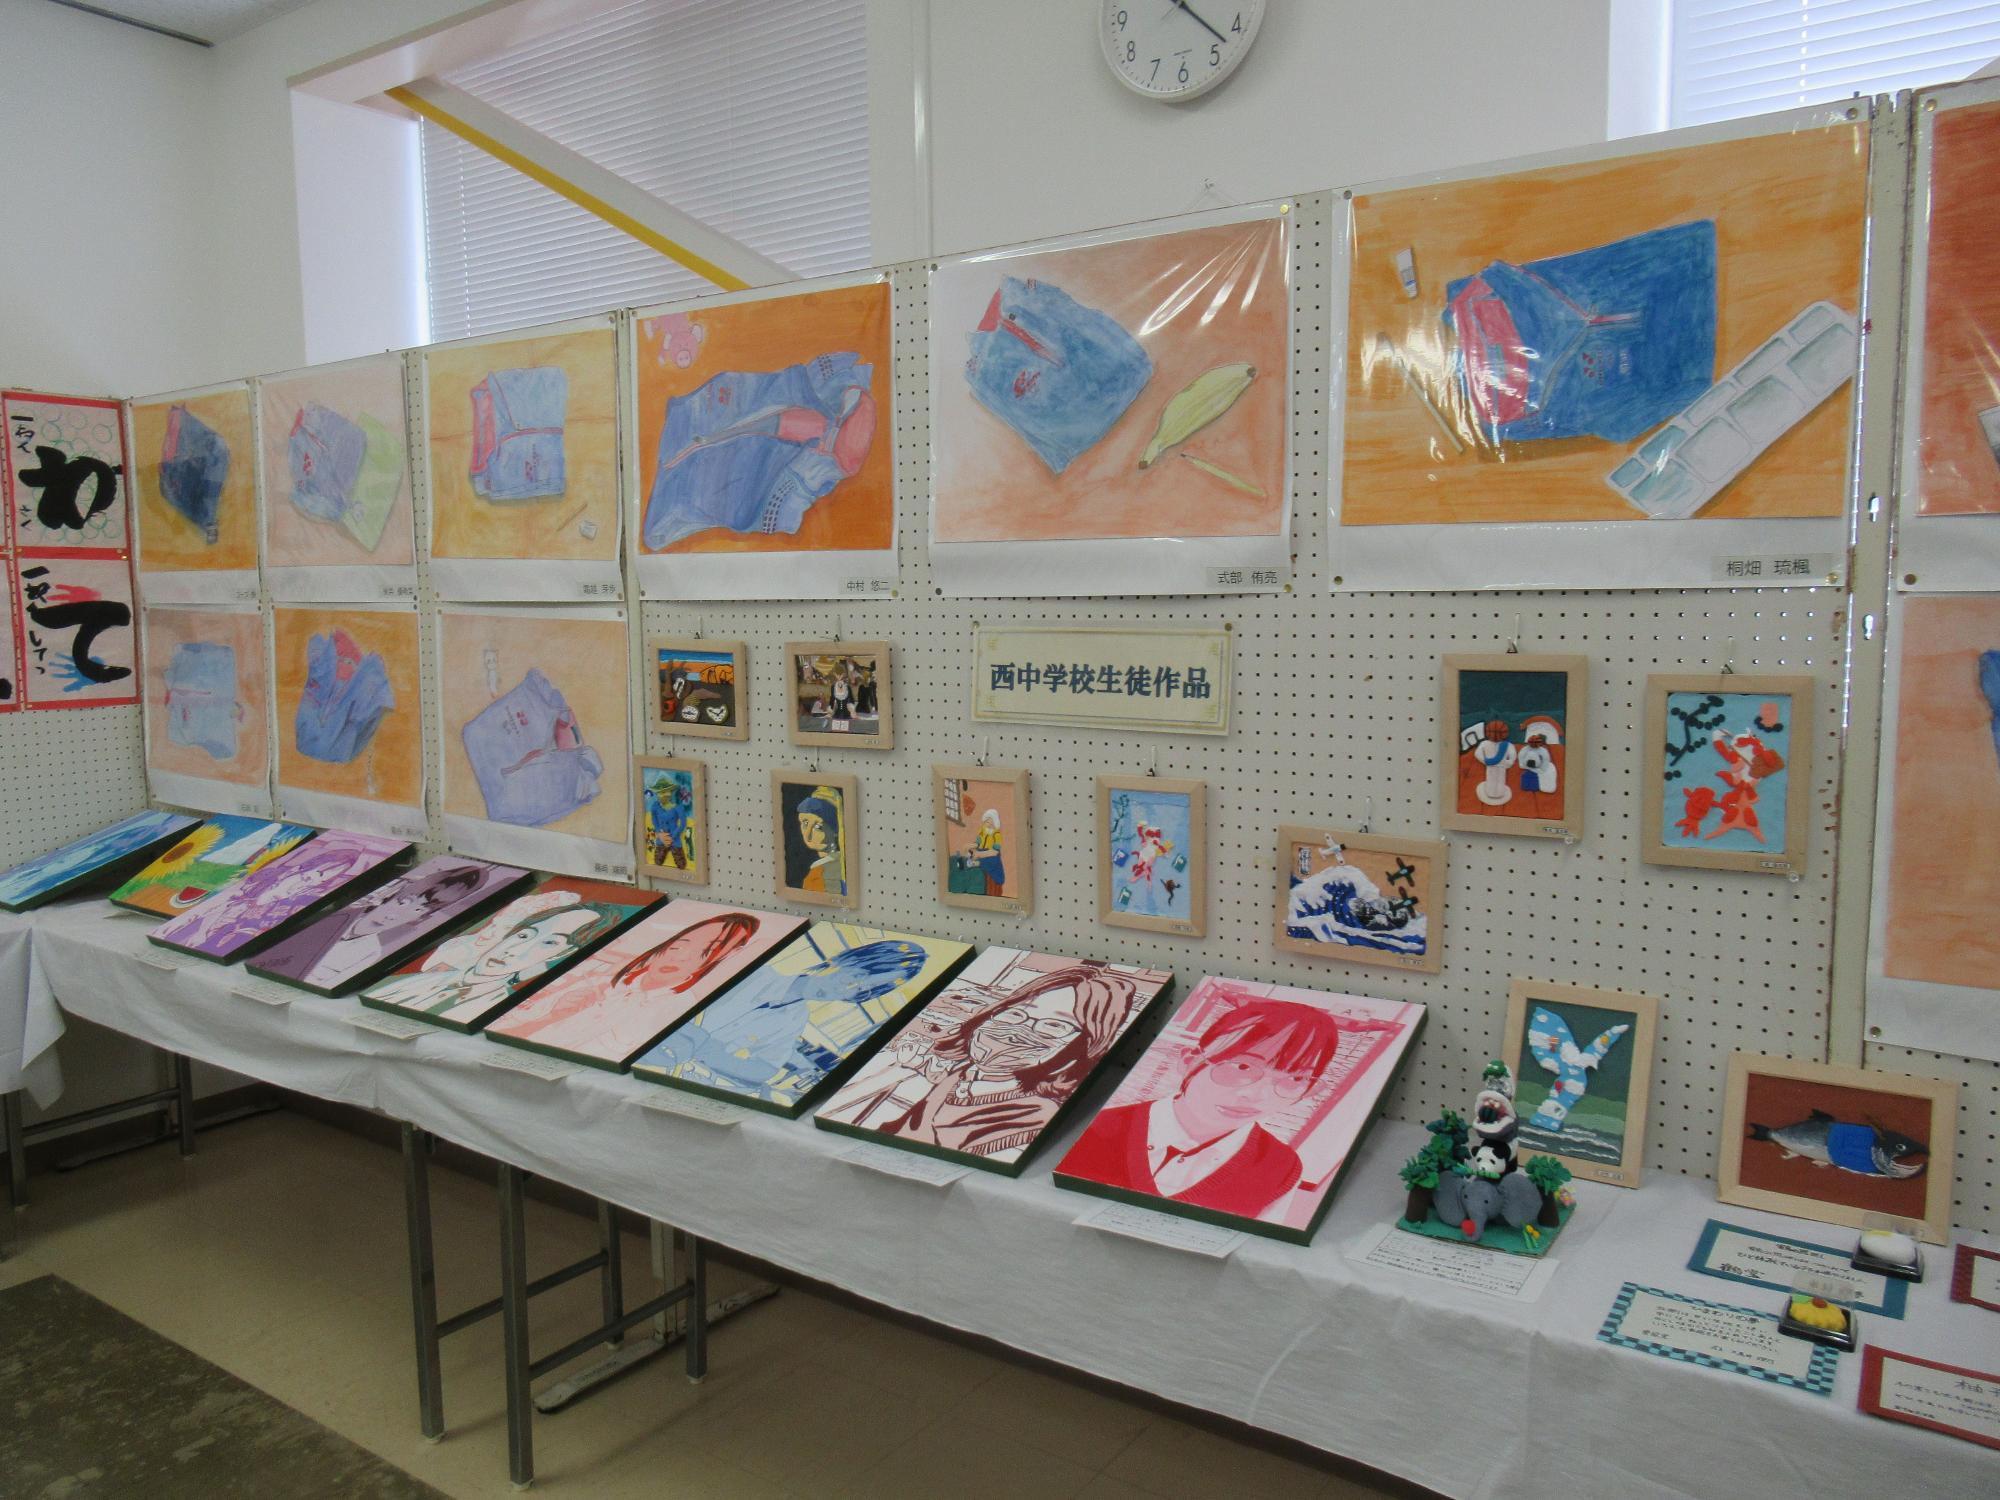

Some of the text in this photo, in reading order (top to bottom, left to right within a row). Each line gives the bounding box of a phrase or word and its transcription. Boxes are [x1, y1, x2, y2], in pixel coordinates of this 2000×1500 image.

[1117, 10, 1128, 31] 9
[1231, 12, 1242, 33] 4
[1126, 40, 1136, 62] 8
[1209, 44, 1221, 66] 5
[1151, 58, 1161, 81] 7
[1178, 61, 1189, 83] 6
[1217, 571, 1243, 585] 式部
[990, 662, 1211, 699] 西中学校生徒作品
